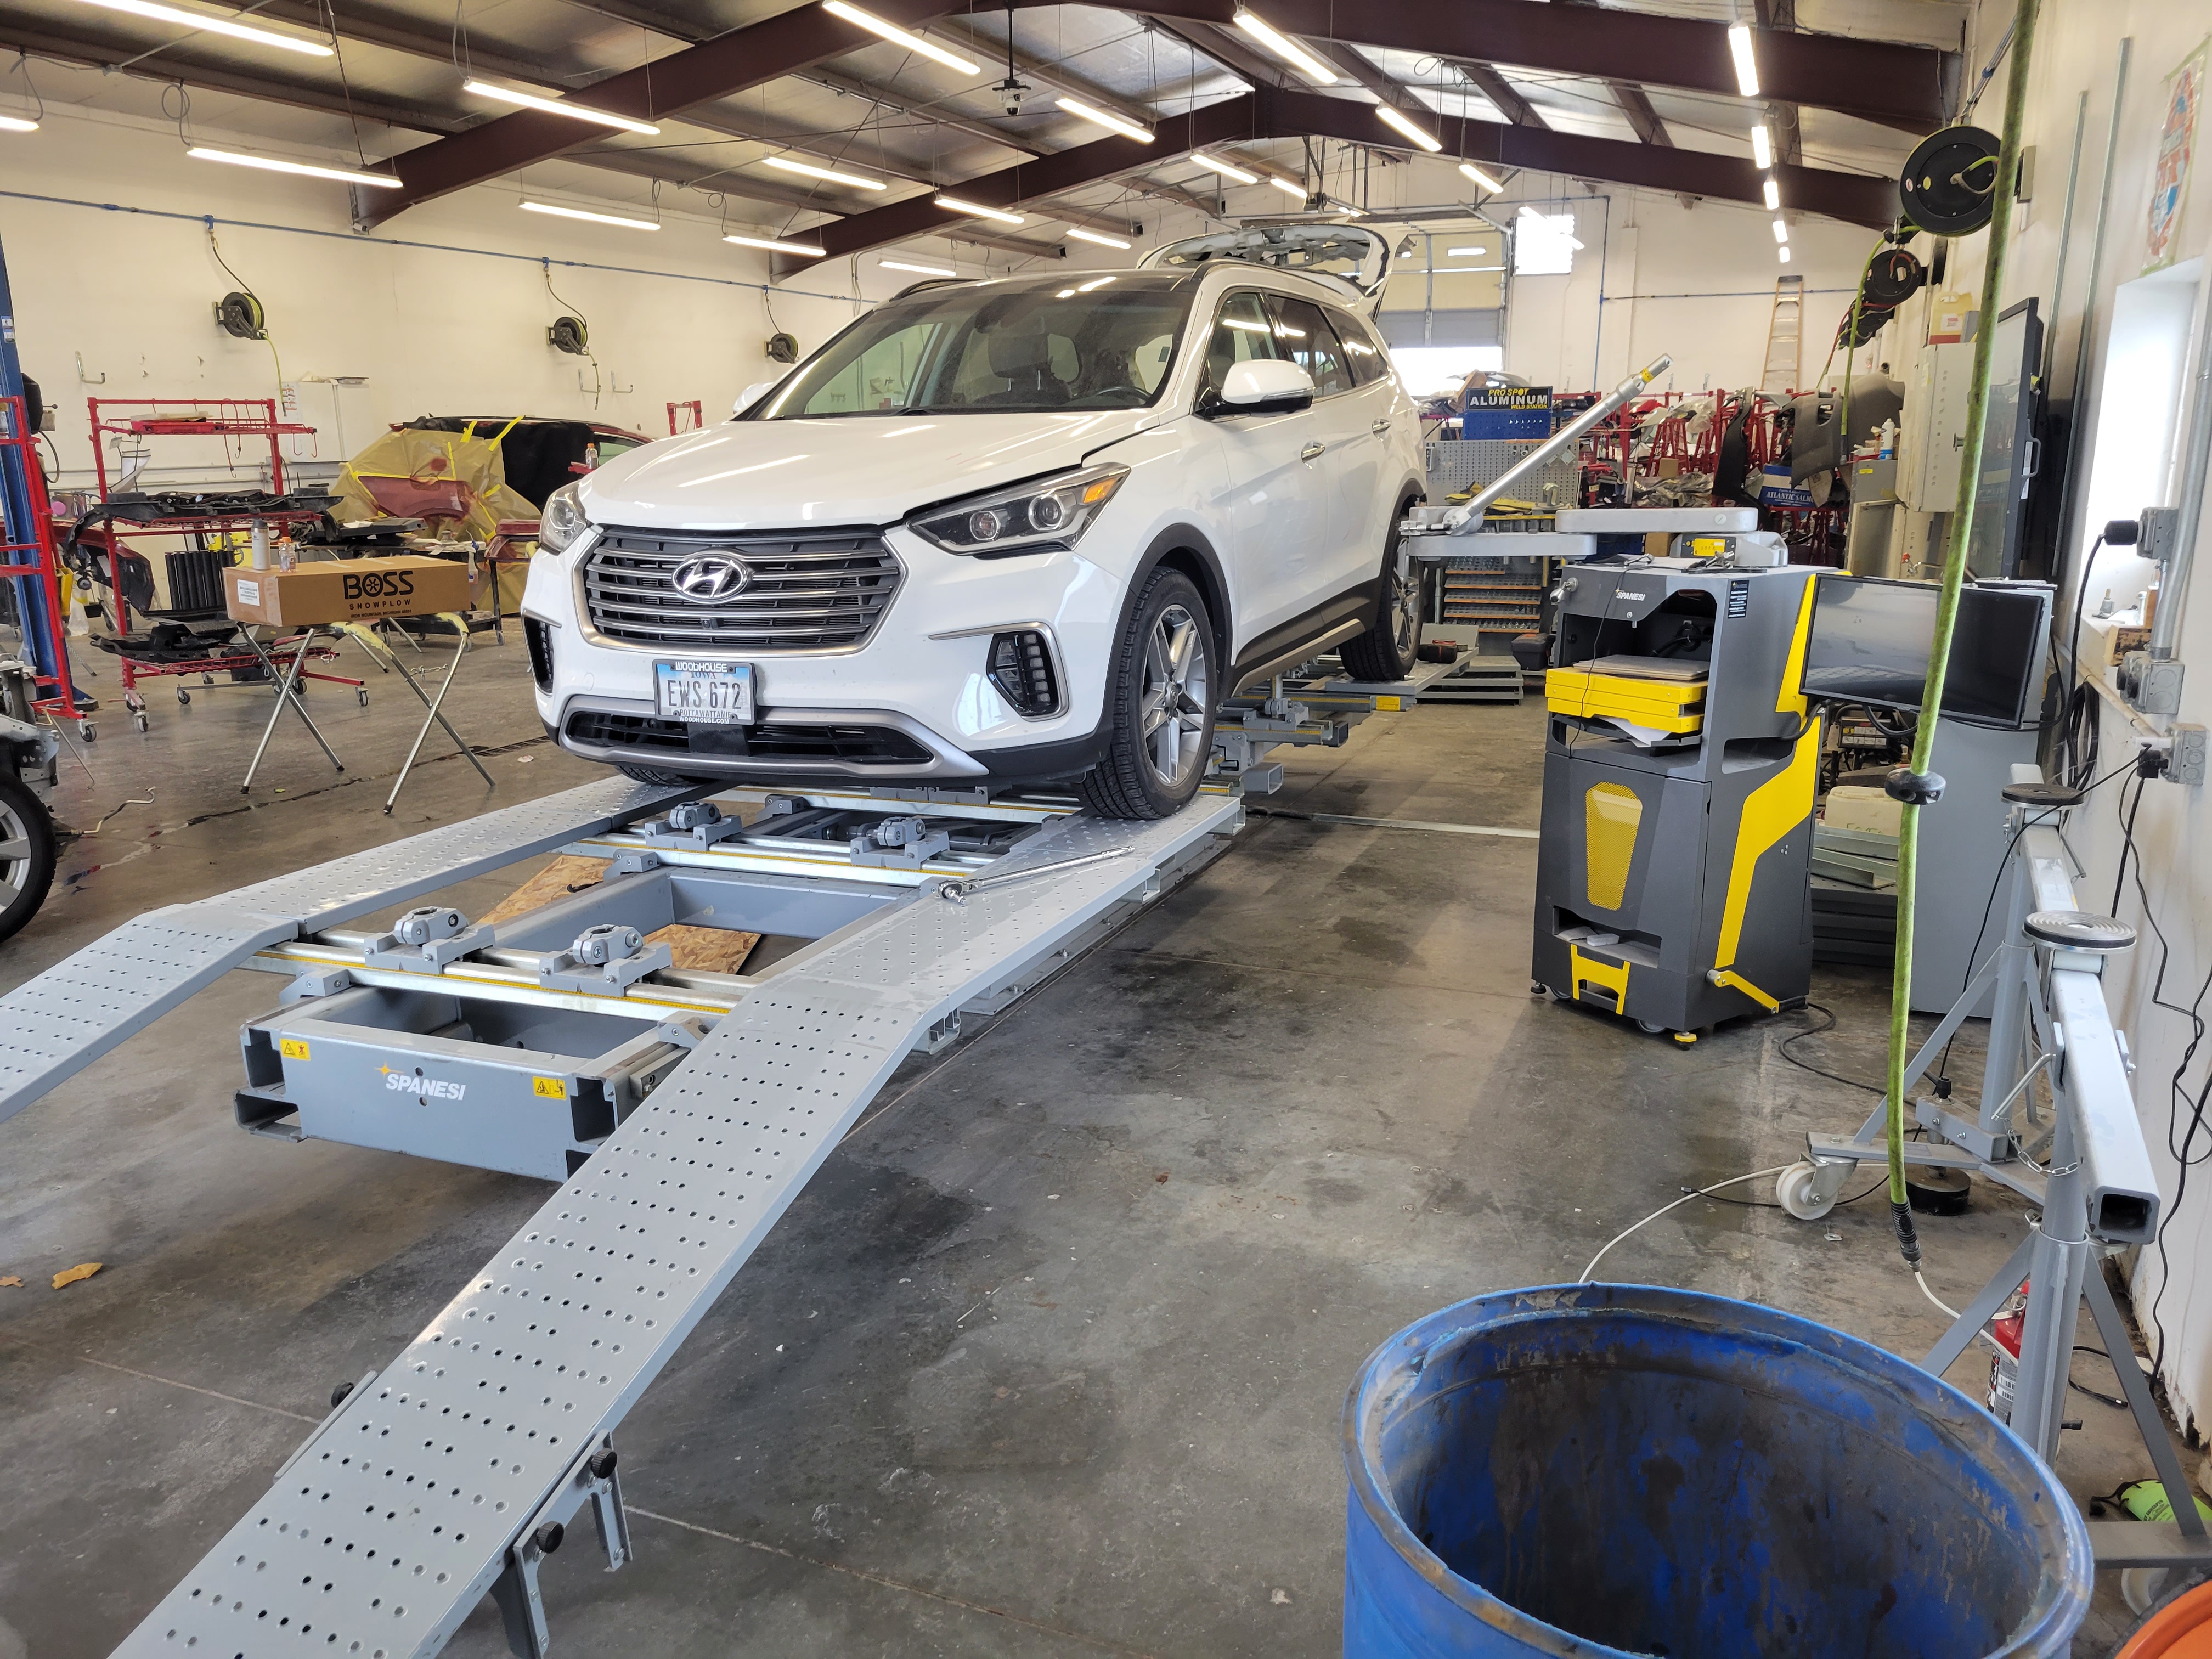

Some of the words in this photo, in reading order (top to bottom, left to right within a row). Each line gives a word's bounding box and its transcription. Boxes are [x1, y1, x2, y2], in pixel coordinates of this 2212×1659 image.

[1470, 394, 1548, 406] ALUMINUM
[1766, 491, 1796, 500] ATLANTIC
[343, 571, 414, 599] BOSS
[1616, 591, 1646, 601] SPANESI
[349, 599, 410, 610] SNOWPLOW
[675, 662, 727, 673] WOODHOUSE
[667, 680, 702, 708] EWS
[709, 681, 742, 710] 672
[679, 709, 731, 719] POTTAWATTAMIE
[679, 716, 729, 724] WOODHOUSE.COM
[386, 1073, 466, 1101] SPANESI
